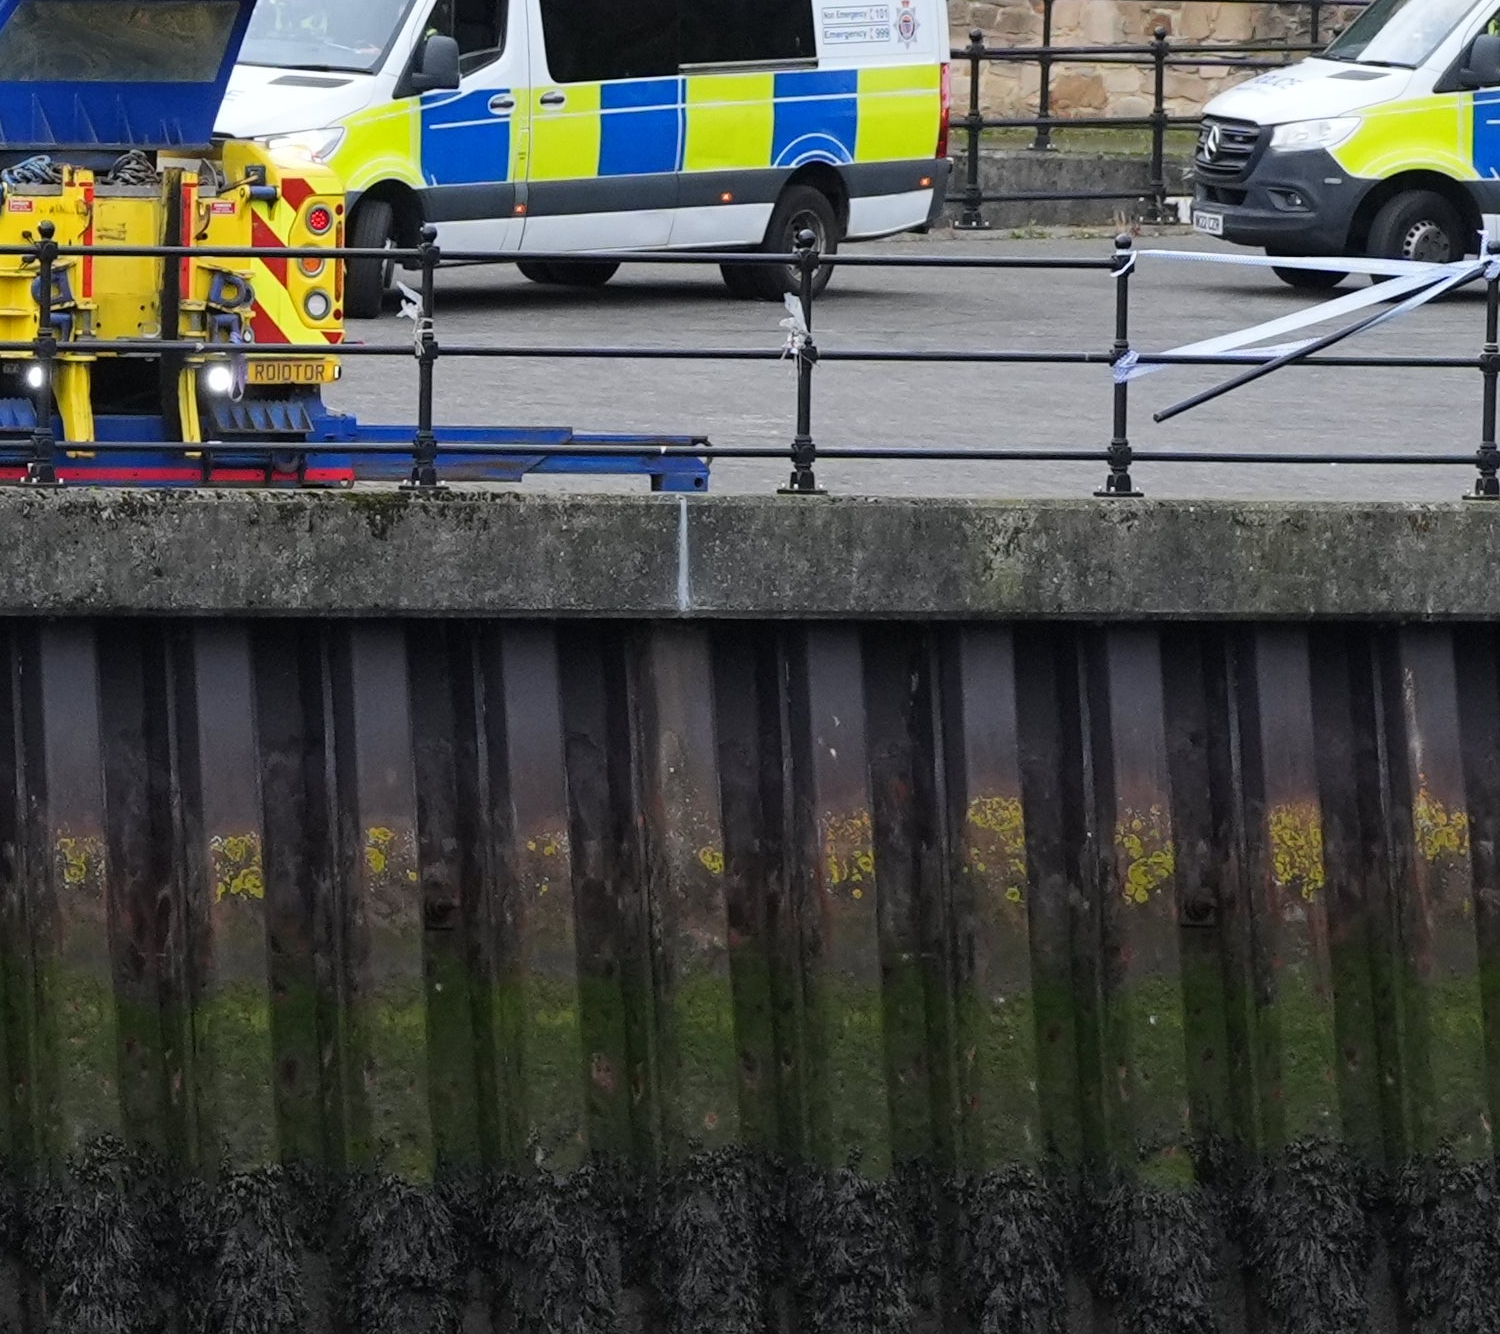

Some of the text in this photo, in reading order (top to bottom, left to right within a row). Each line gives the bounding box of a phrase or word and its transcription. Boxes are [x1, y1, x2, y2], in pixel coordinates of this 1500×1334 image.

[875, 8, 888, 19] 101
[824, 28, 890, 40] Emergency 999
